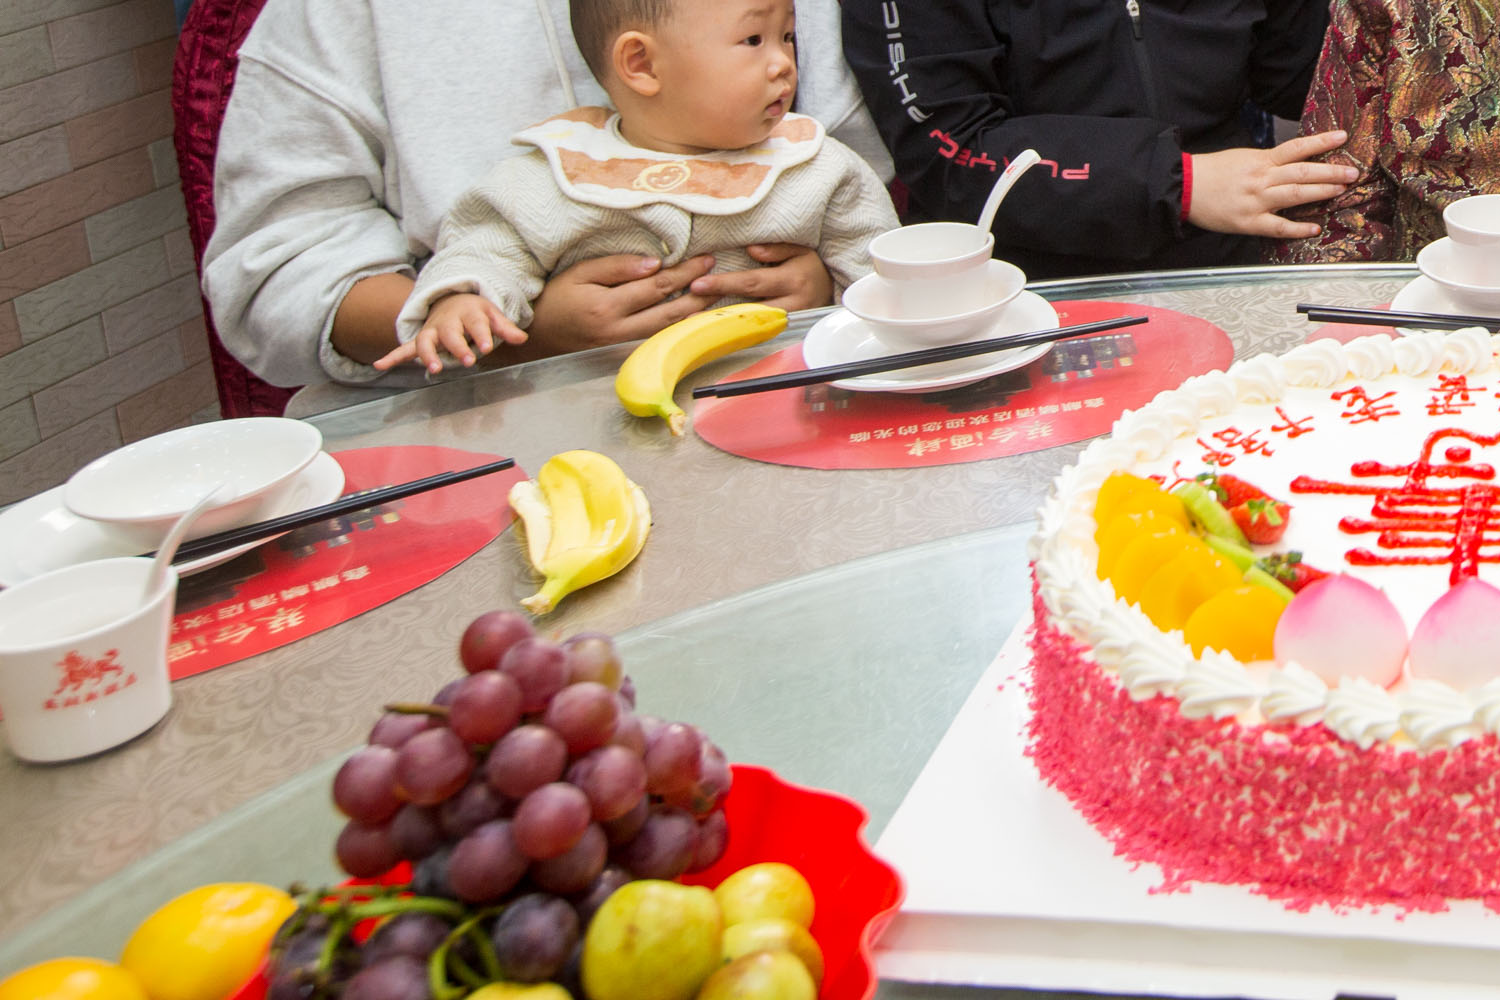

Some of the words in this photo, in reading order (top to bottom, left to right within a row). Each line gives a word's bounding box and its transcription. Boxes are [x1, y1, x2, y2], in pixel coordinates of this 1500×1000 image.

[930, 128, 1090, 181] PLYER
[849, 397, 1105, 443] 鑫麒麟酒店欢迎您的光临
